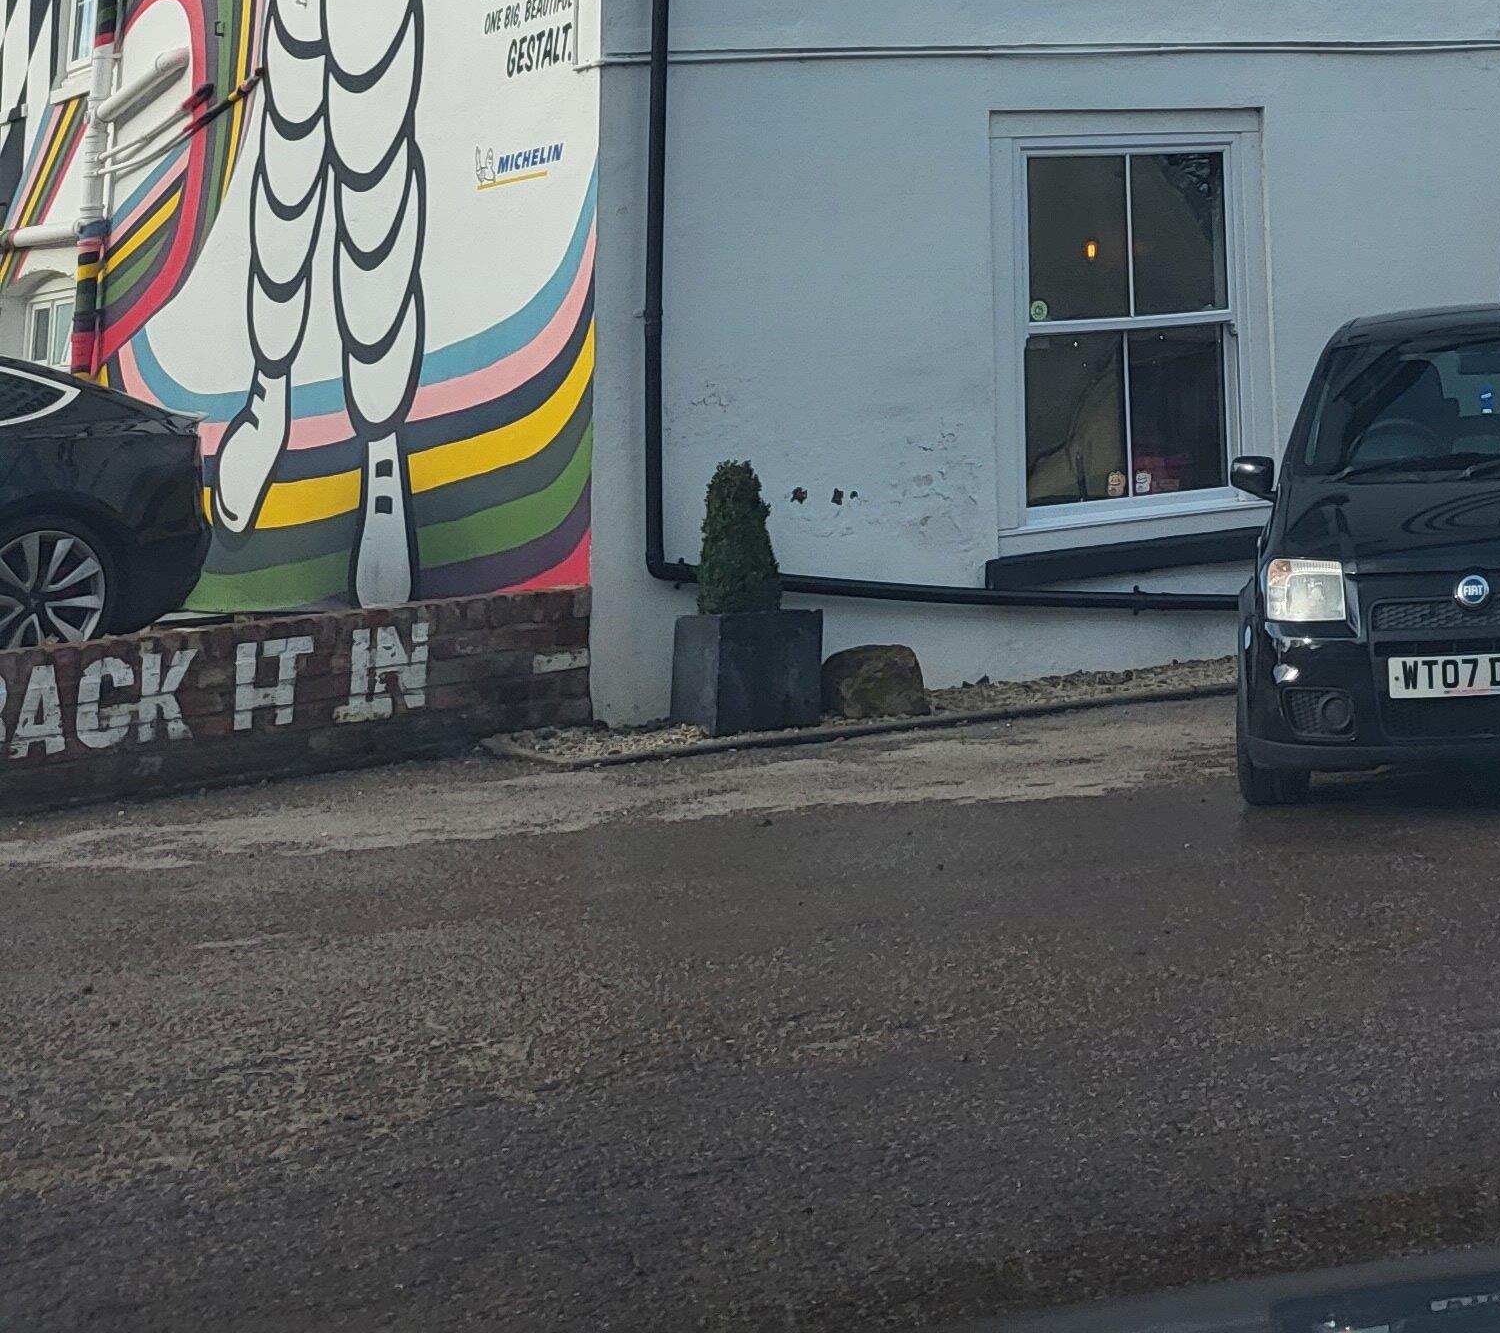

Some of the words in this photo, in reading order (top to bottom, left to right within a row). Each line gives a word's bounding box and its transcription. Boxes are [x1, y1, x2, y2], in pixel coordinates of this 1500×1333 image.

[484, 7, 503, 35] ONE
[504, 2, 521, 29] BIG,
[507, 22, 572, 78] GESTALT.
[497, 142, 564, 175] MICHELIN
[1463, 585, 1483, 597] FIAT
[0, 649, 198, 759] ACK
[333, 622, 430, 724] IN
[1402, 658, 1479, 690] WT07
